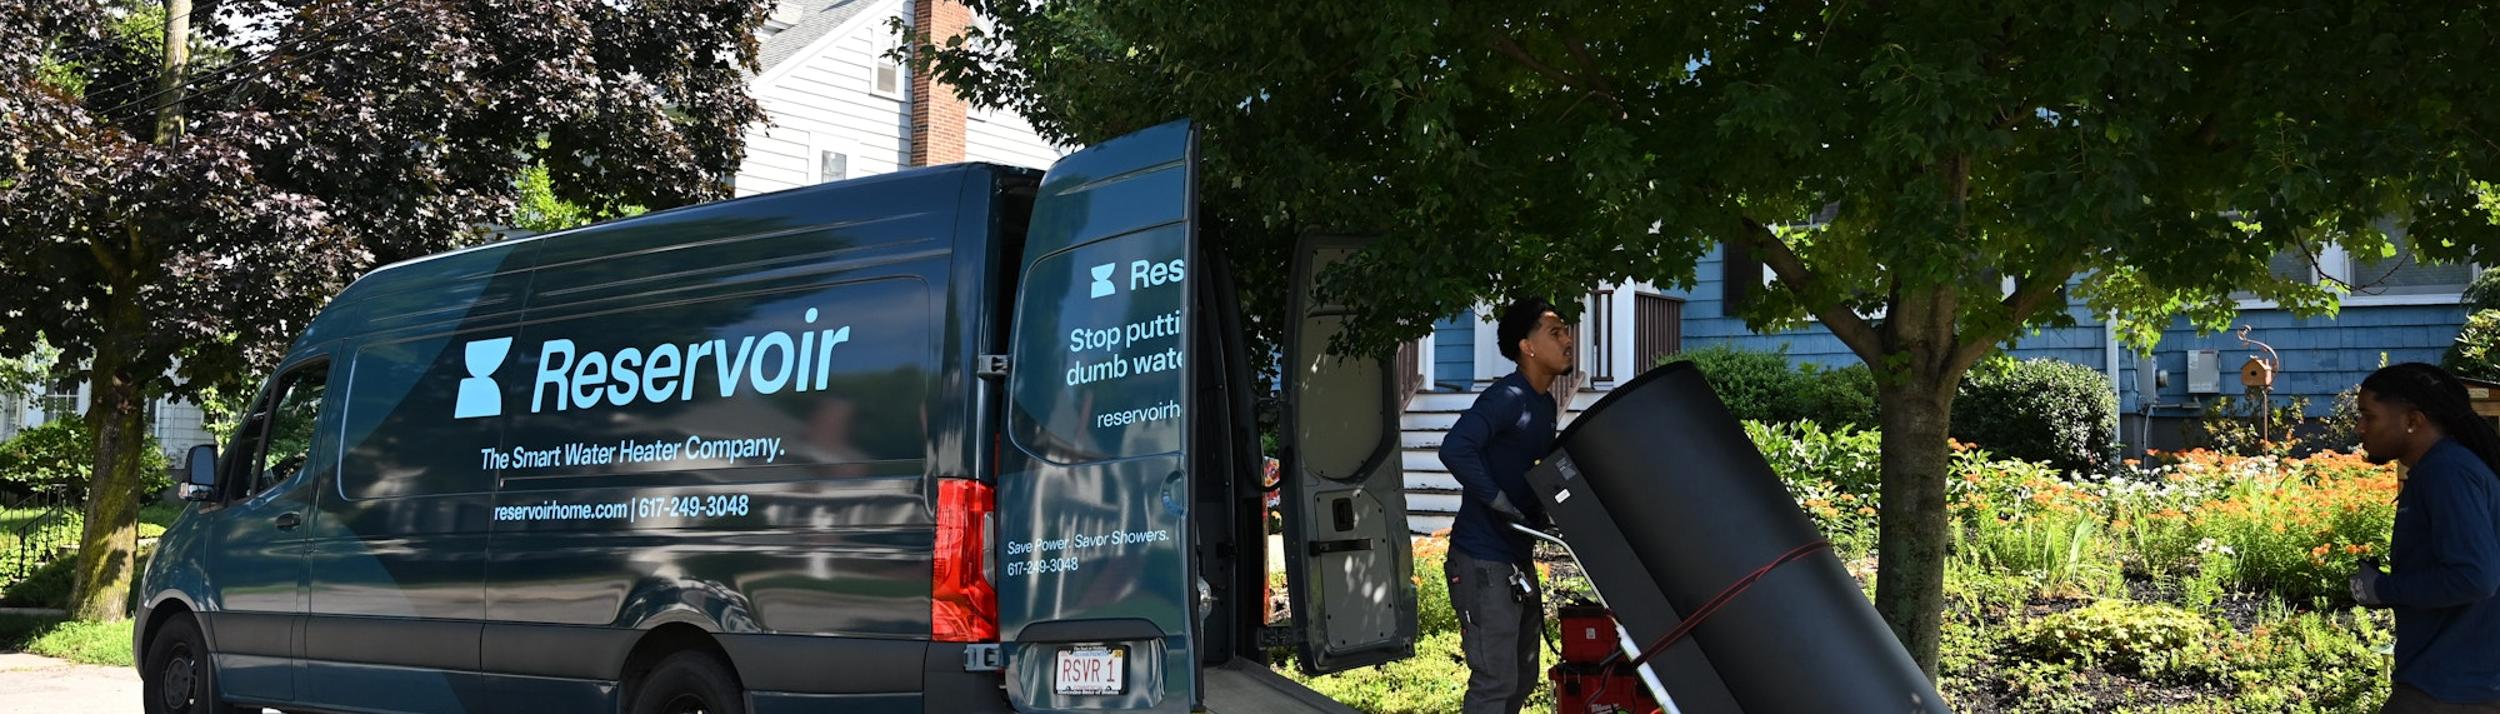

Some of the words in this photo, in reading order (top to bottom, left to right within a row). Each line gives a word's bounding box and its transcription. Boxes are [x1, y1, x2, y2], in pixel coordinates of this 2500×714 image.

[1070, 327, 1120, 352] Stop
[1126, 310, 1180, 348] putti
[531, 307, 850, 413] Reservoir
[1066, 354, 1127, 386] dumb
[1097, 400, 1180, 428] reservoirh
[481, 448, 508, 470] The
[512, 446, 561, 469] Smart
[565, 443, 616, 466] Water
[619, 439, 681, 464] Heater
[685, 435, 785, 464] Company.
[494, 501, 627, 521] reservoirhome.com
[638, 495, 749, 519] 617-249-3048
[1007, 541, 1032, 555] Save
[1034, 538, 1071, 552] Power.
[1074, 534, 1109, 548] Savor
[1111, 529, 1169, 545] Showers.
[1007, 557, 1078, 576] 617-249-3048
[1062, 658, 1101, 683] RSVR
[1106, 660, 1115, 682] 1
